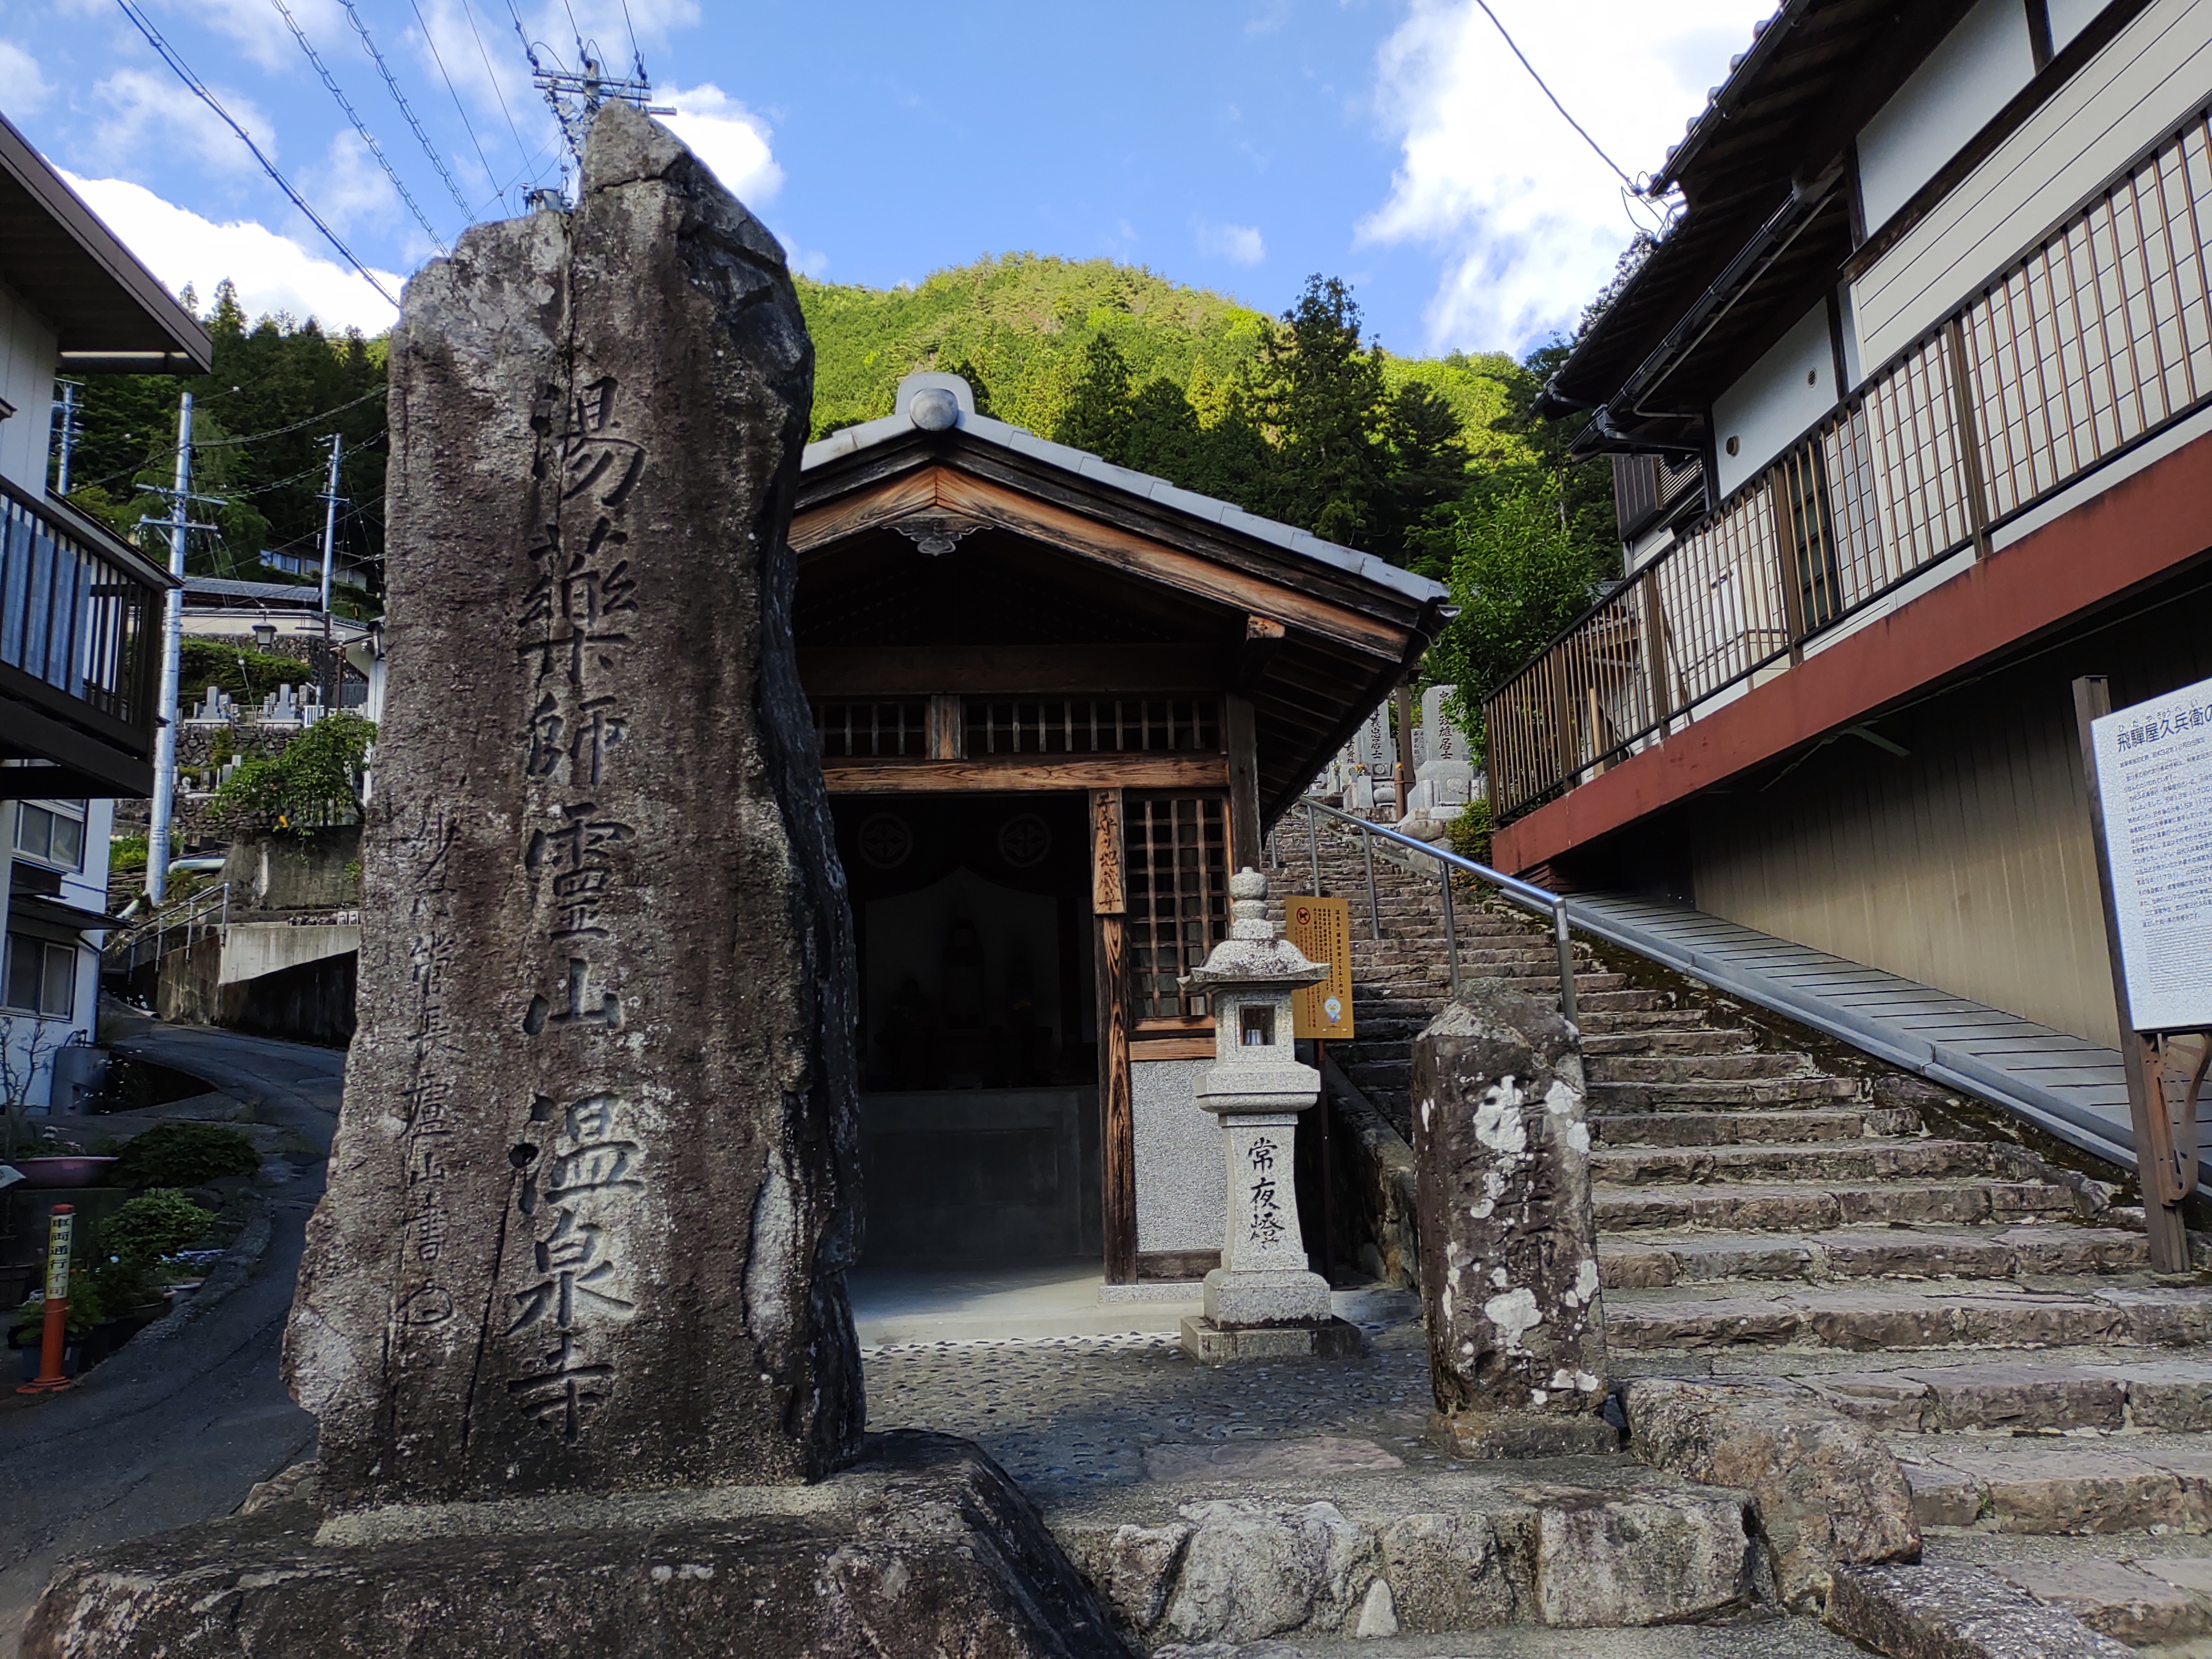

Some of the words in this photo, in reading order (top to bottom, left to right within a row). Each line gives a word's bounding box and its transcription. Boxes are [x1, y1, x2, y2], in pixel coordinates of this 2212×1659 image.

[49, 1218, 70, 1297] 車両通行不可
